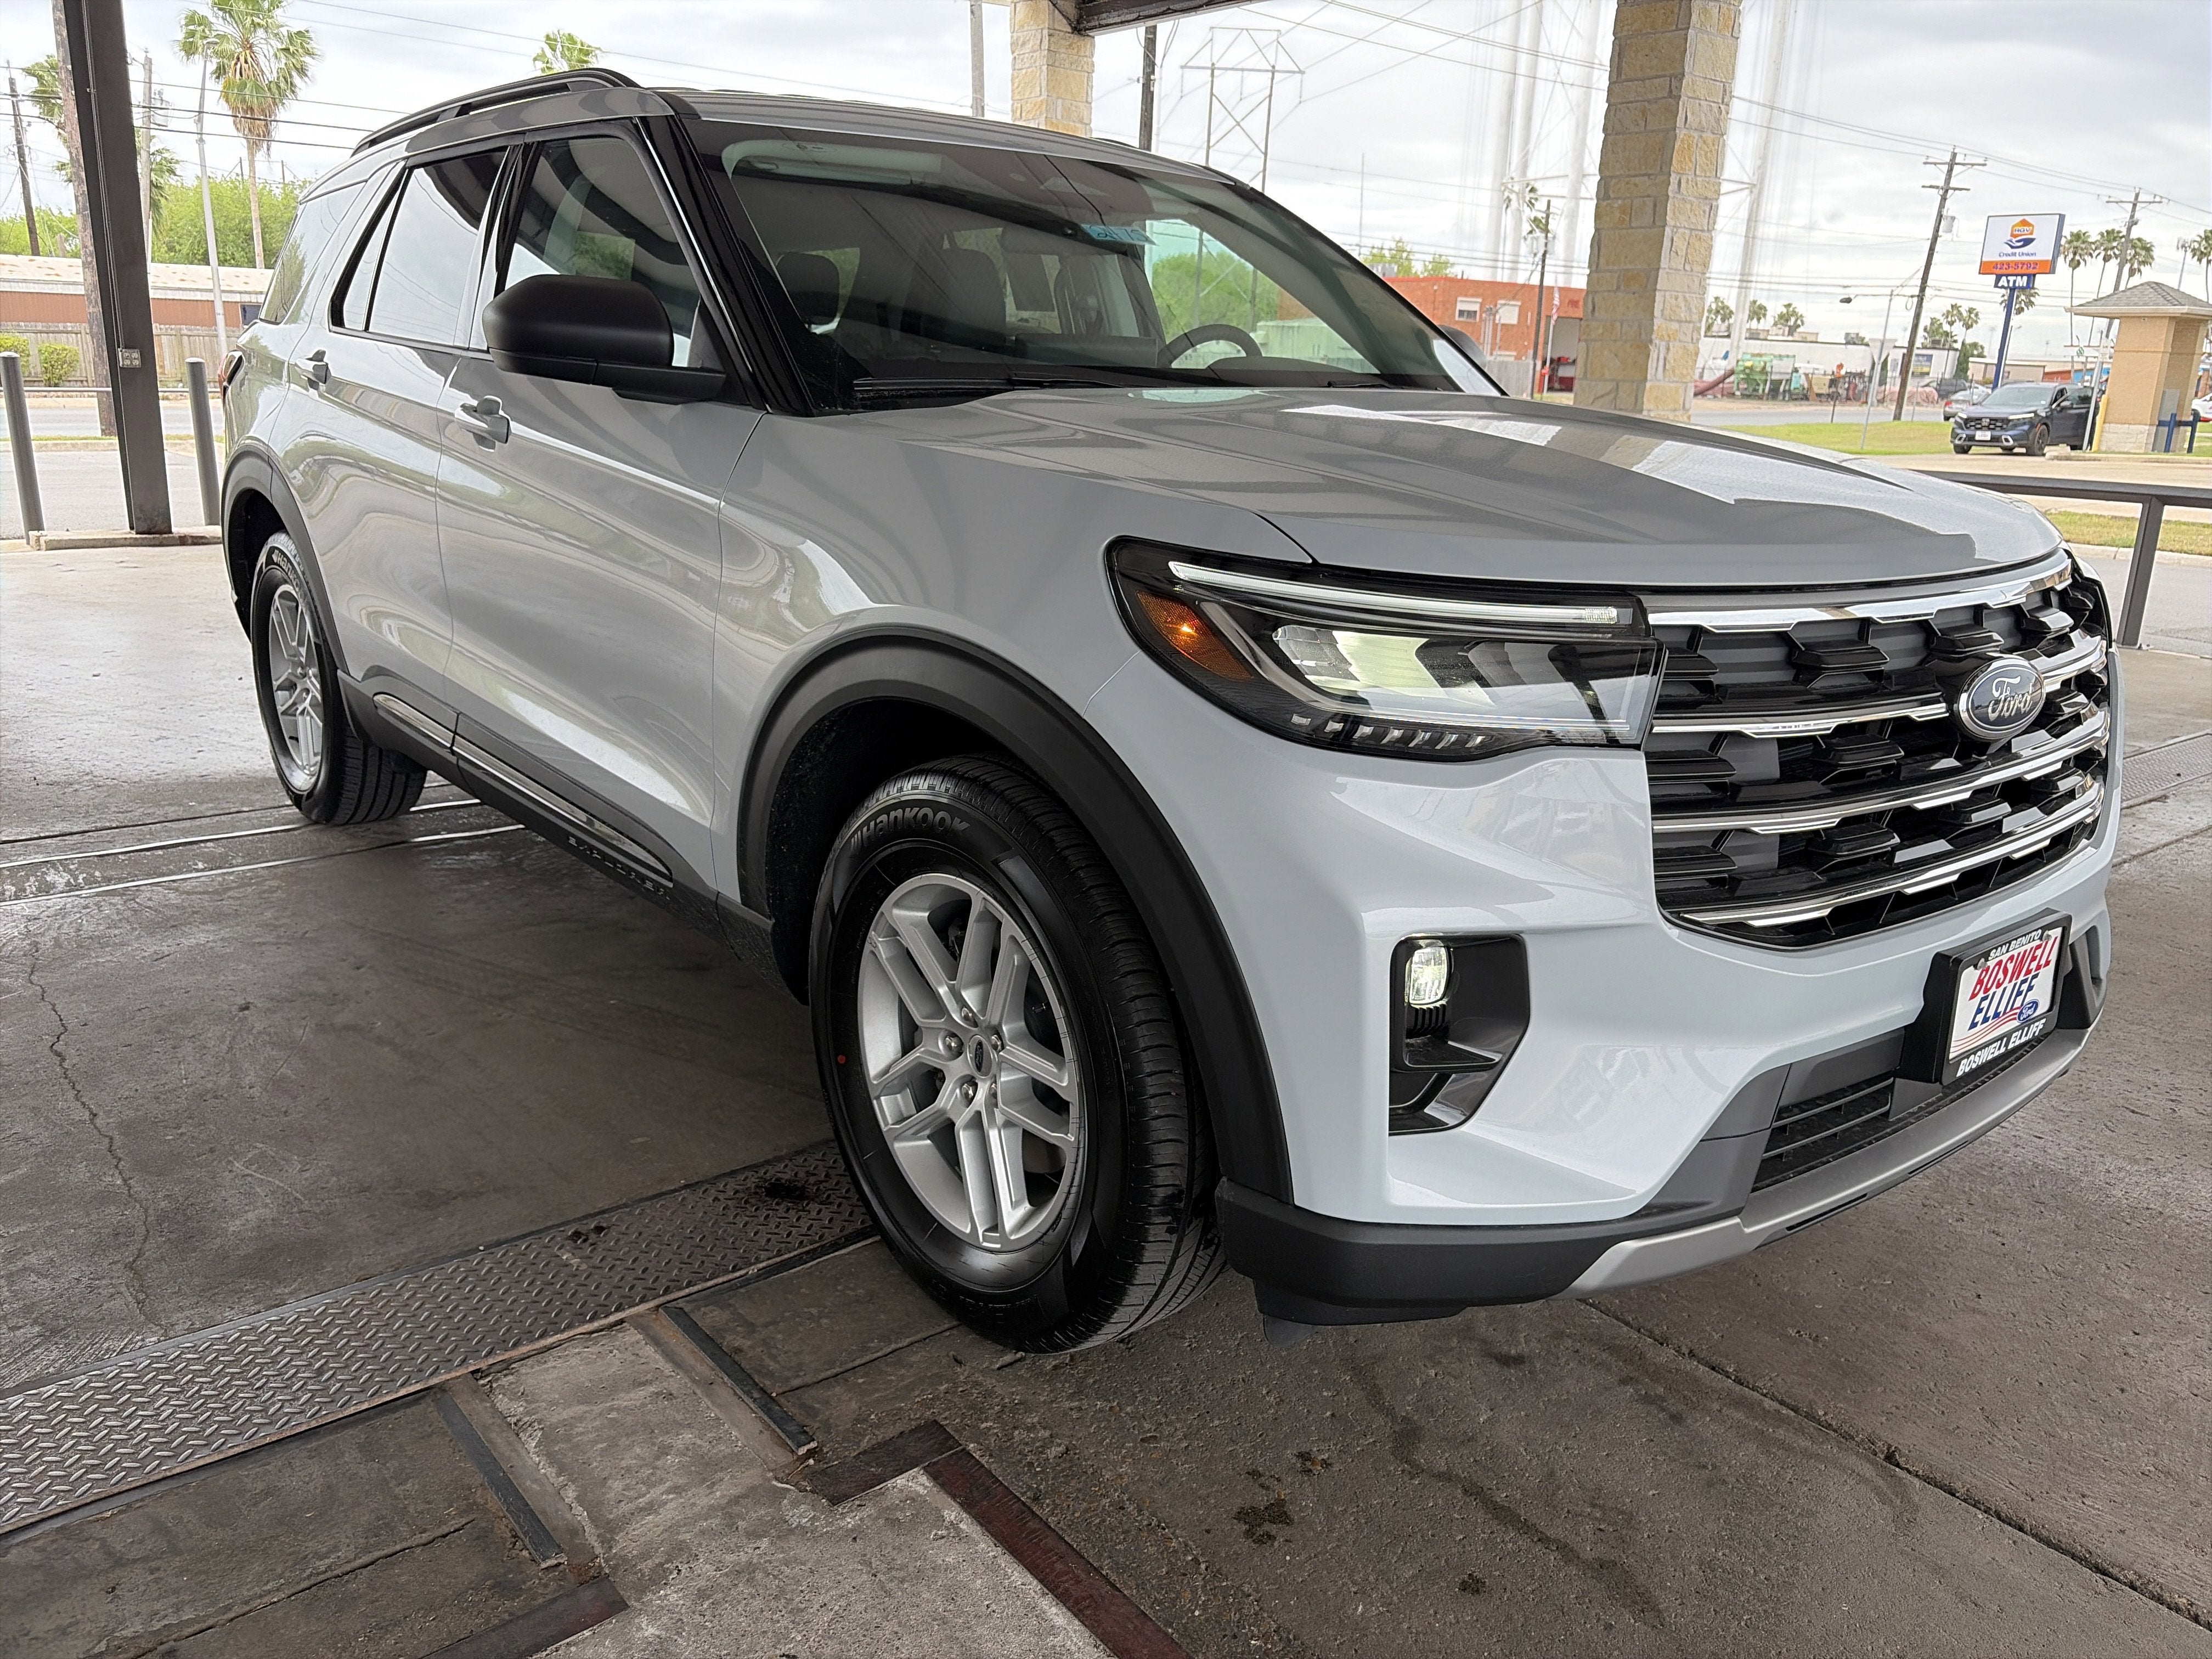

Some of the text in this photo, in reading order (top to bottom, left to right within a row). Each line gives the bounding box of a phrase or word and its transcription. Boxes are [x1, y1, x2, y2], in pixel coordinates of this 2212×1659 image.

[1997, 275, 2028, 287] ATM
[1988, 675, 2033, 722] Ford
[1968, 936, 2058, 1001] BOSWELL
[1988, 929, 2042, 960] SAN BENITO
[1967, 972, 2040, 1031] ELLIFF
[1956, 1018, 2046, 1077] BOSWELL ELLIFF
